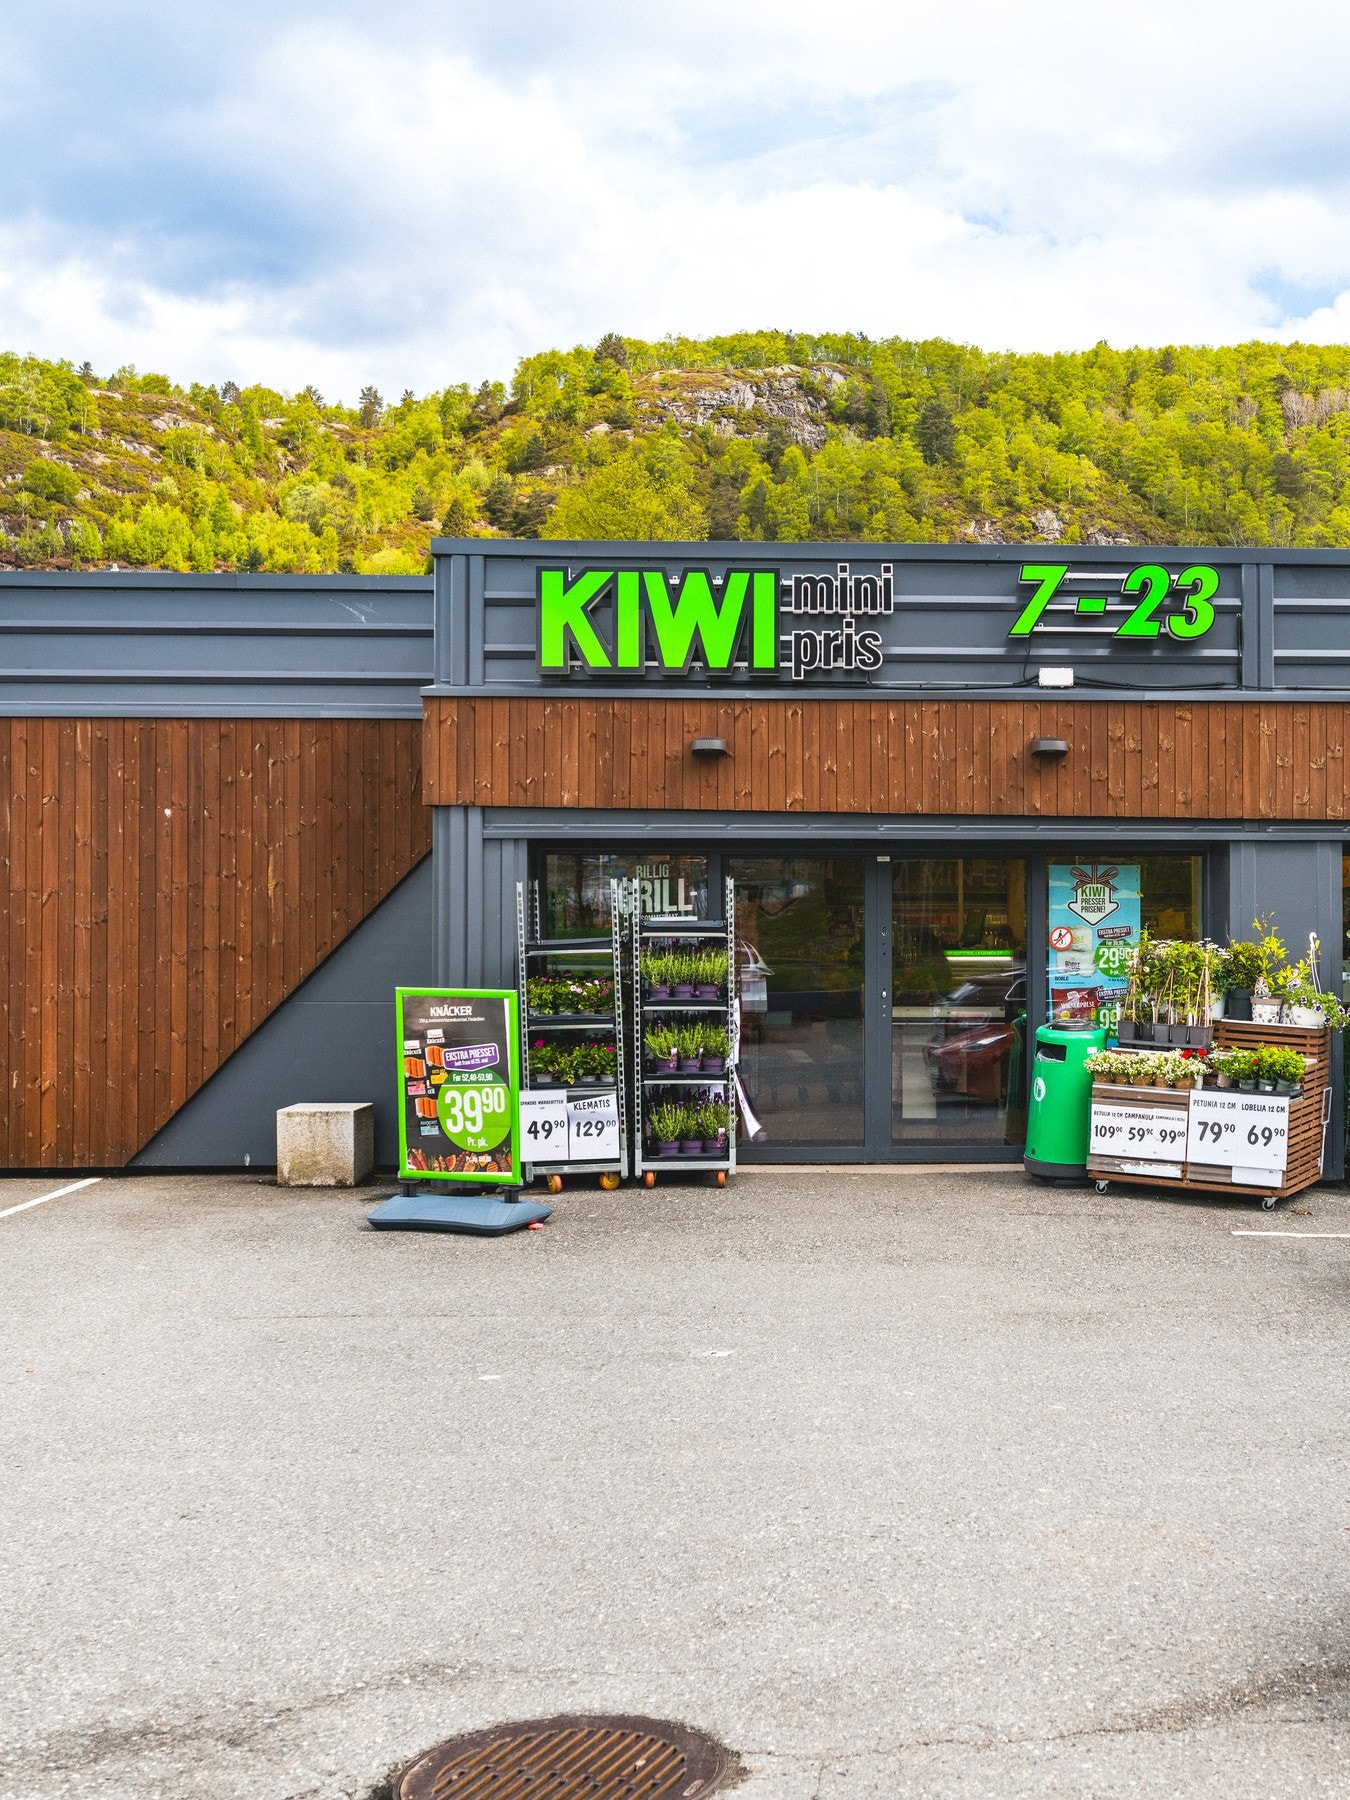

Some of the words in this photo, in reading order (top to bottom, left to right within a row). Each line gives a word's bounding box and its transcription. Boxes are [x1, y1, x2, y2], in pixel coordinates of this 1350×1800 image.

[792, 563, 893, 614] mini
[538, 568, 778, 673] KIWI
[792, 619, 883, 679] pris
[1081, 886, 1106, 897] KIWI
[1081, 898, 1106, 906] PRESSER
[1081, 906, 1106, 914] PRISENE!
[430, 1004, 472, 1017] KNÄCKER
[445, 1050, 468, 1062] EKSTRA
[469, 1046, 495, 1058] PRESSET
[573, 1099, 611, 1111] KLEMATIS
[1193, 1099, 1218, 1108] PETUNIA
[1227, 1102, 1237, 1110] CM
[1241, 1103, 1267, 1112] LOBELIA
[1268, 1105, 1275, 1113] 12
[1276, 1105, 1286, 1113] CM
[1124, 1112, 1154, 1121] CAMPANULA
